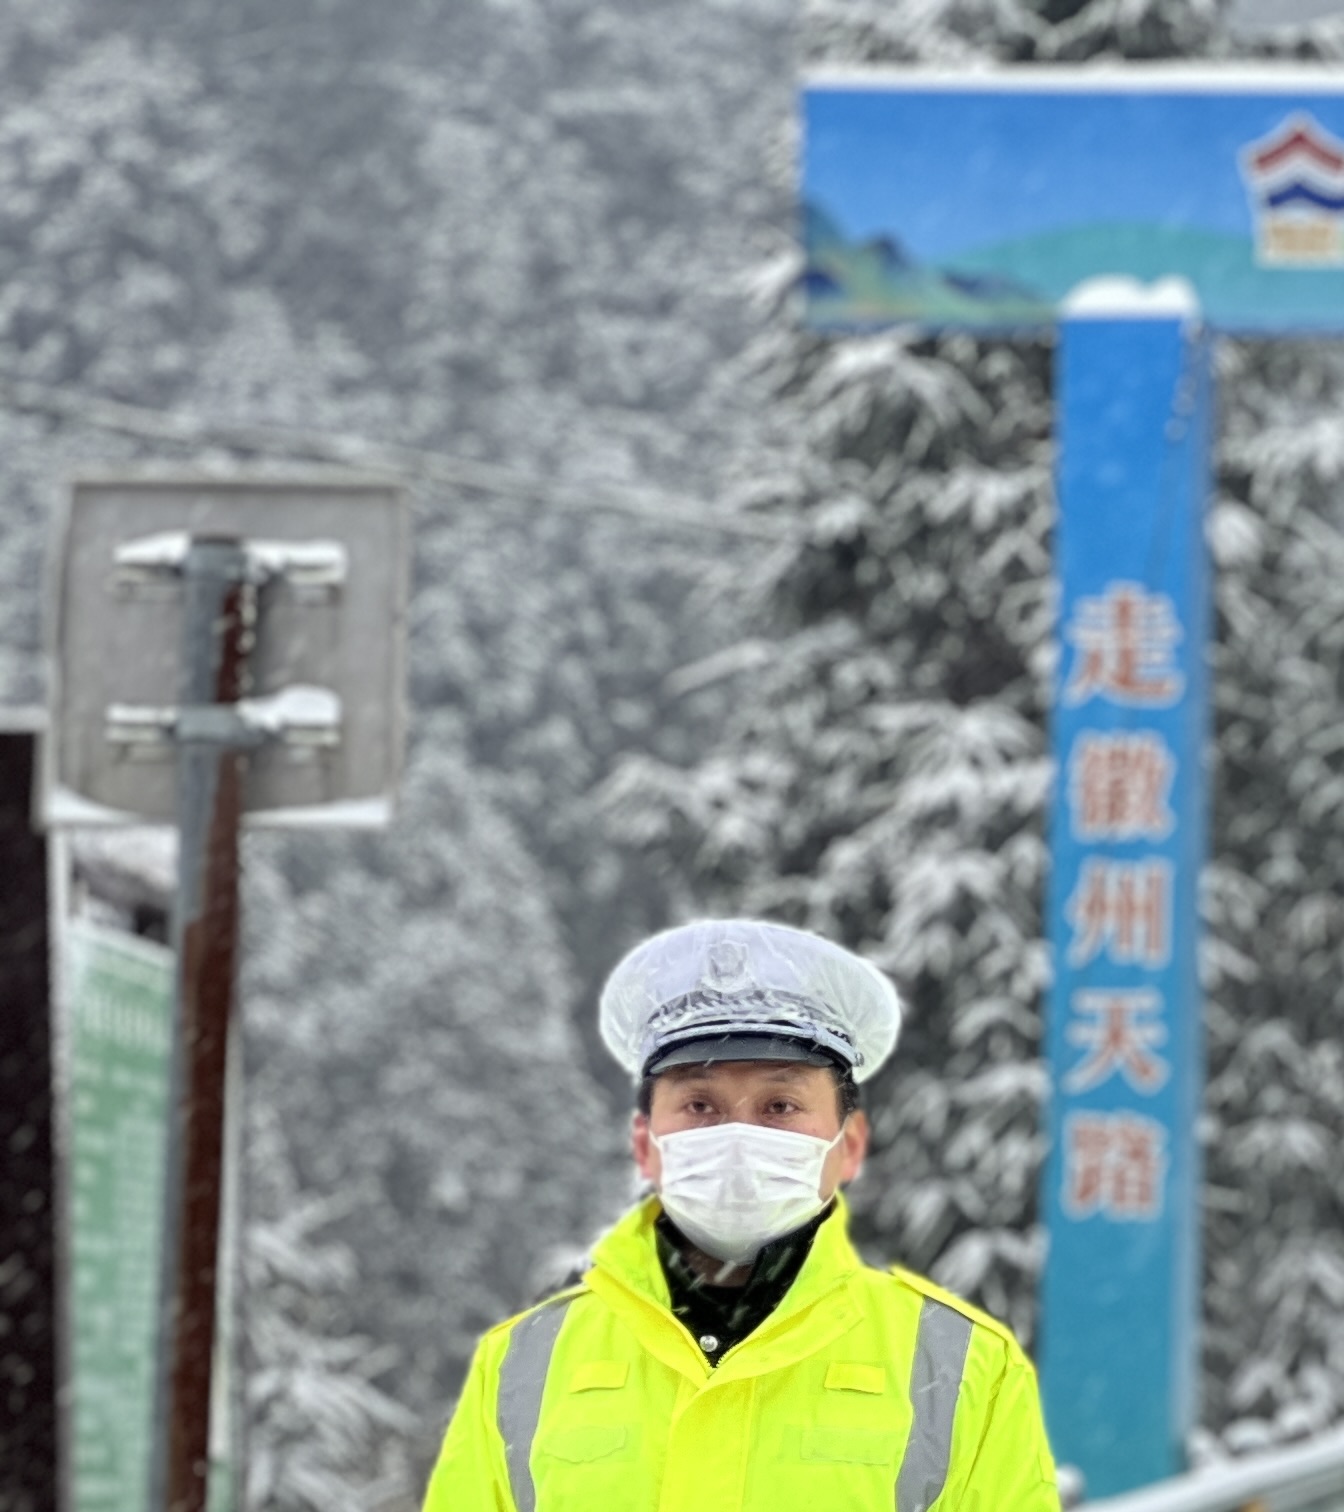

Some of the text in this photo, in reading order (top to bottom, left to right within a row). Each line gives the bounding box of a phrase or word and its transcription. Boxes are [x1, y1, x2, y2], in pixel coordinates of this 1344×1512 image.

[1062, 583, 1185, 1220] 走徽州天路
